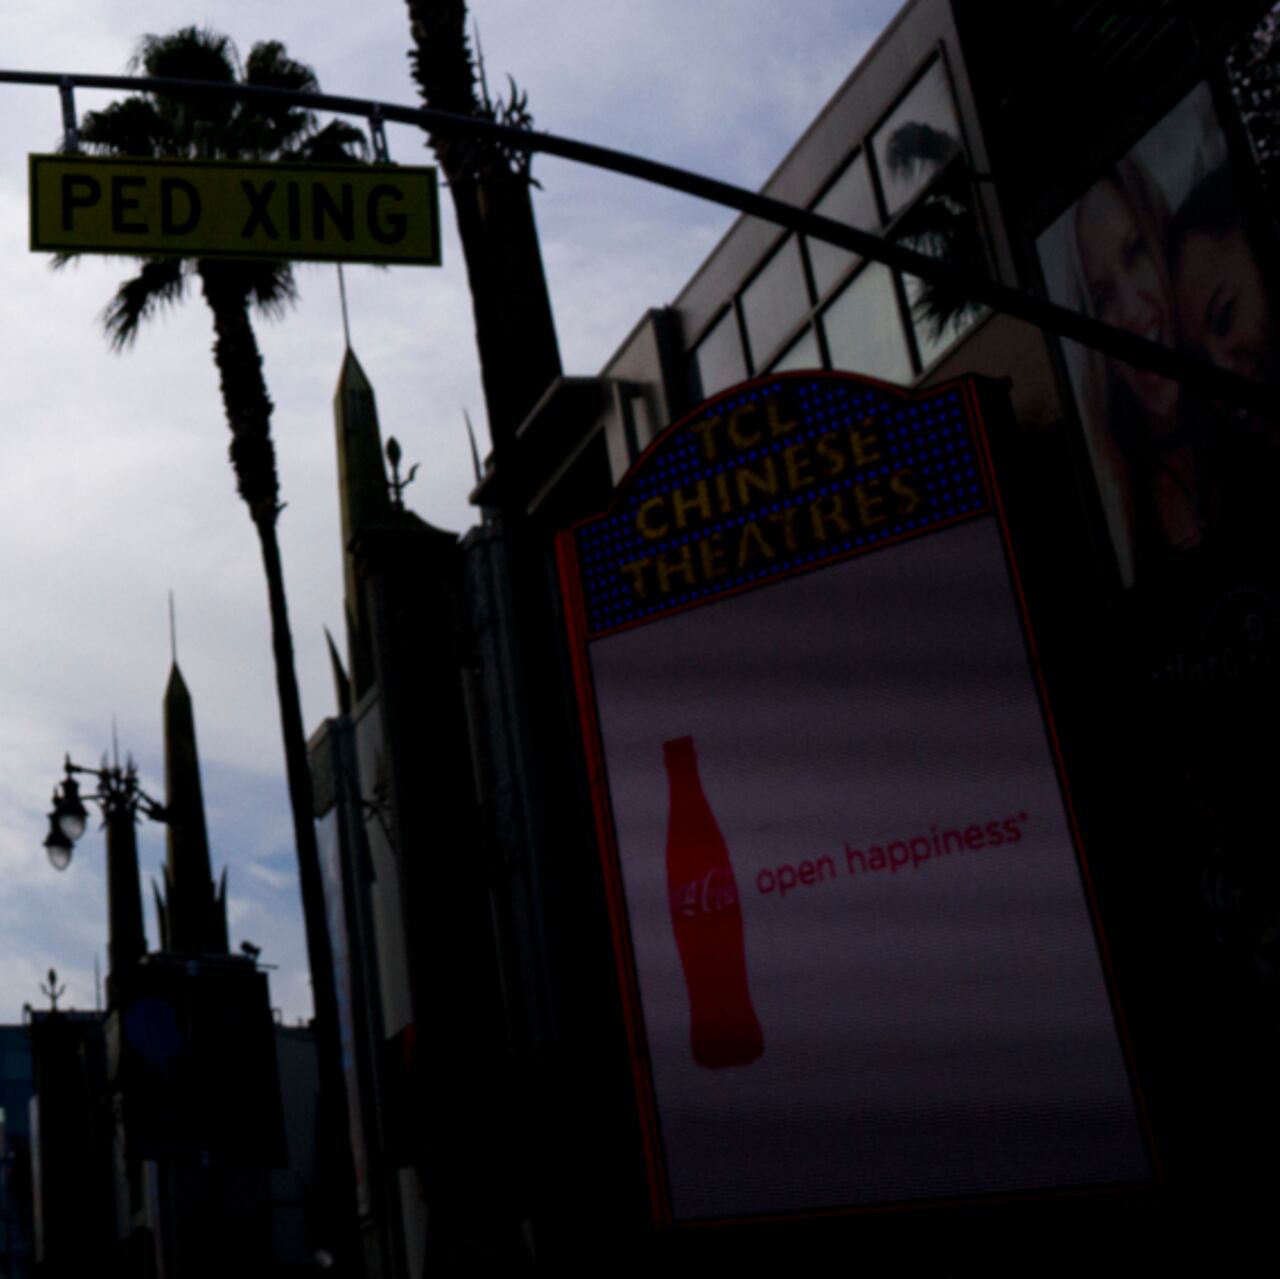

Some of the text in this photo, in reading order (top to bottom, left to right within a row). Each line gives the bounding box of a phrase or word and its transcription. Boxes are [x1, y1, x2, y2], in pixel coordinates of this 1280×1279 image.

[62, 175, 407, 243] PED XING
[690, 392, 798, 463] TCL
[635, 416, 883, 542] CHINESE
[619, 468, 923, 601] THEATRES
[756, 855, 837, 896] open
